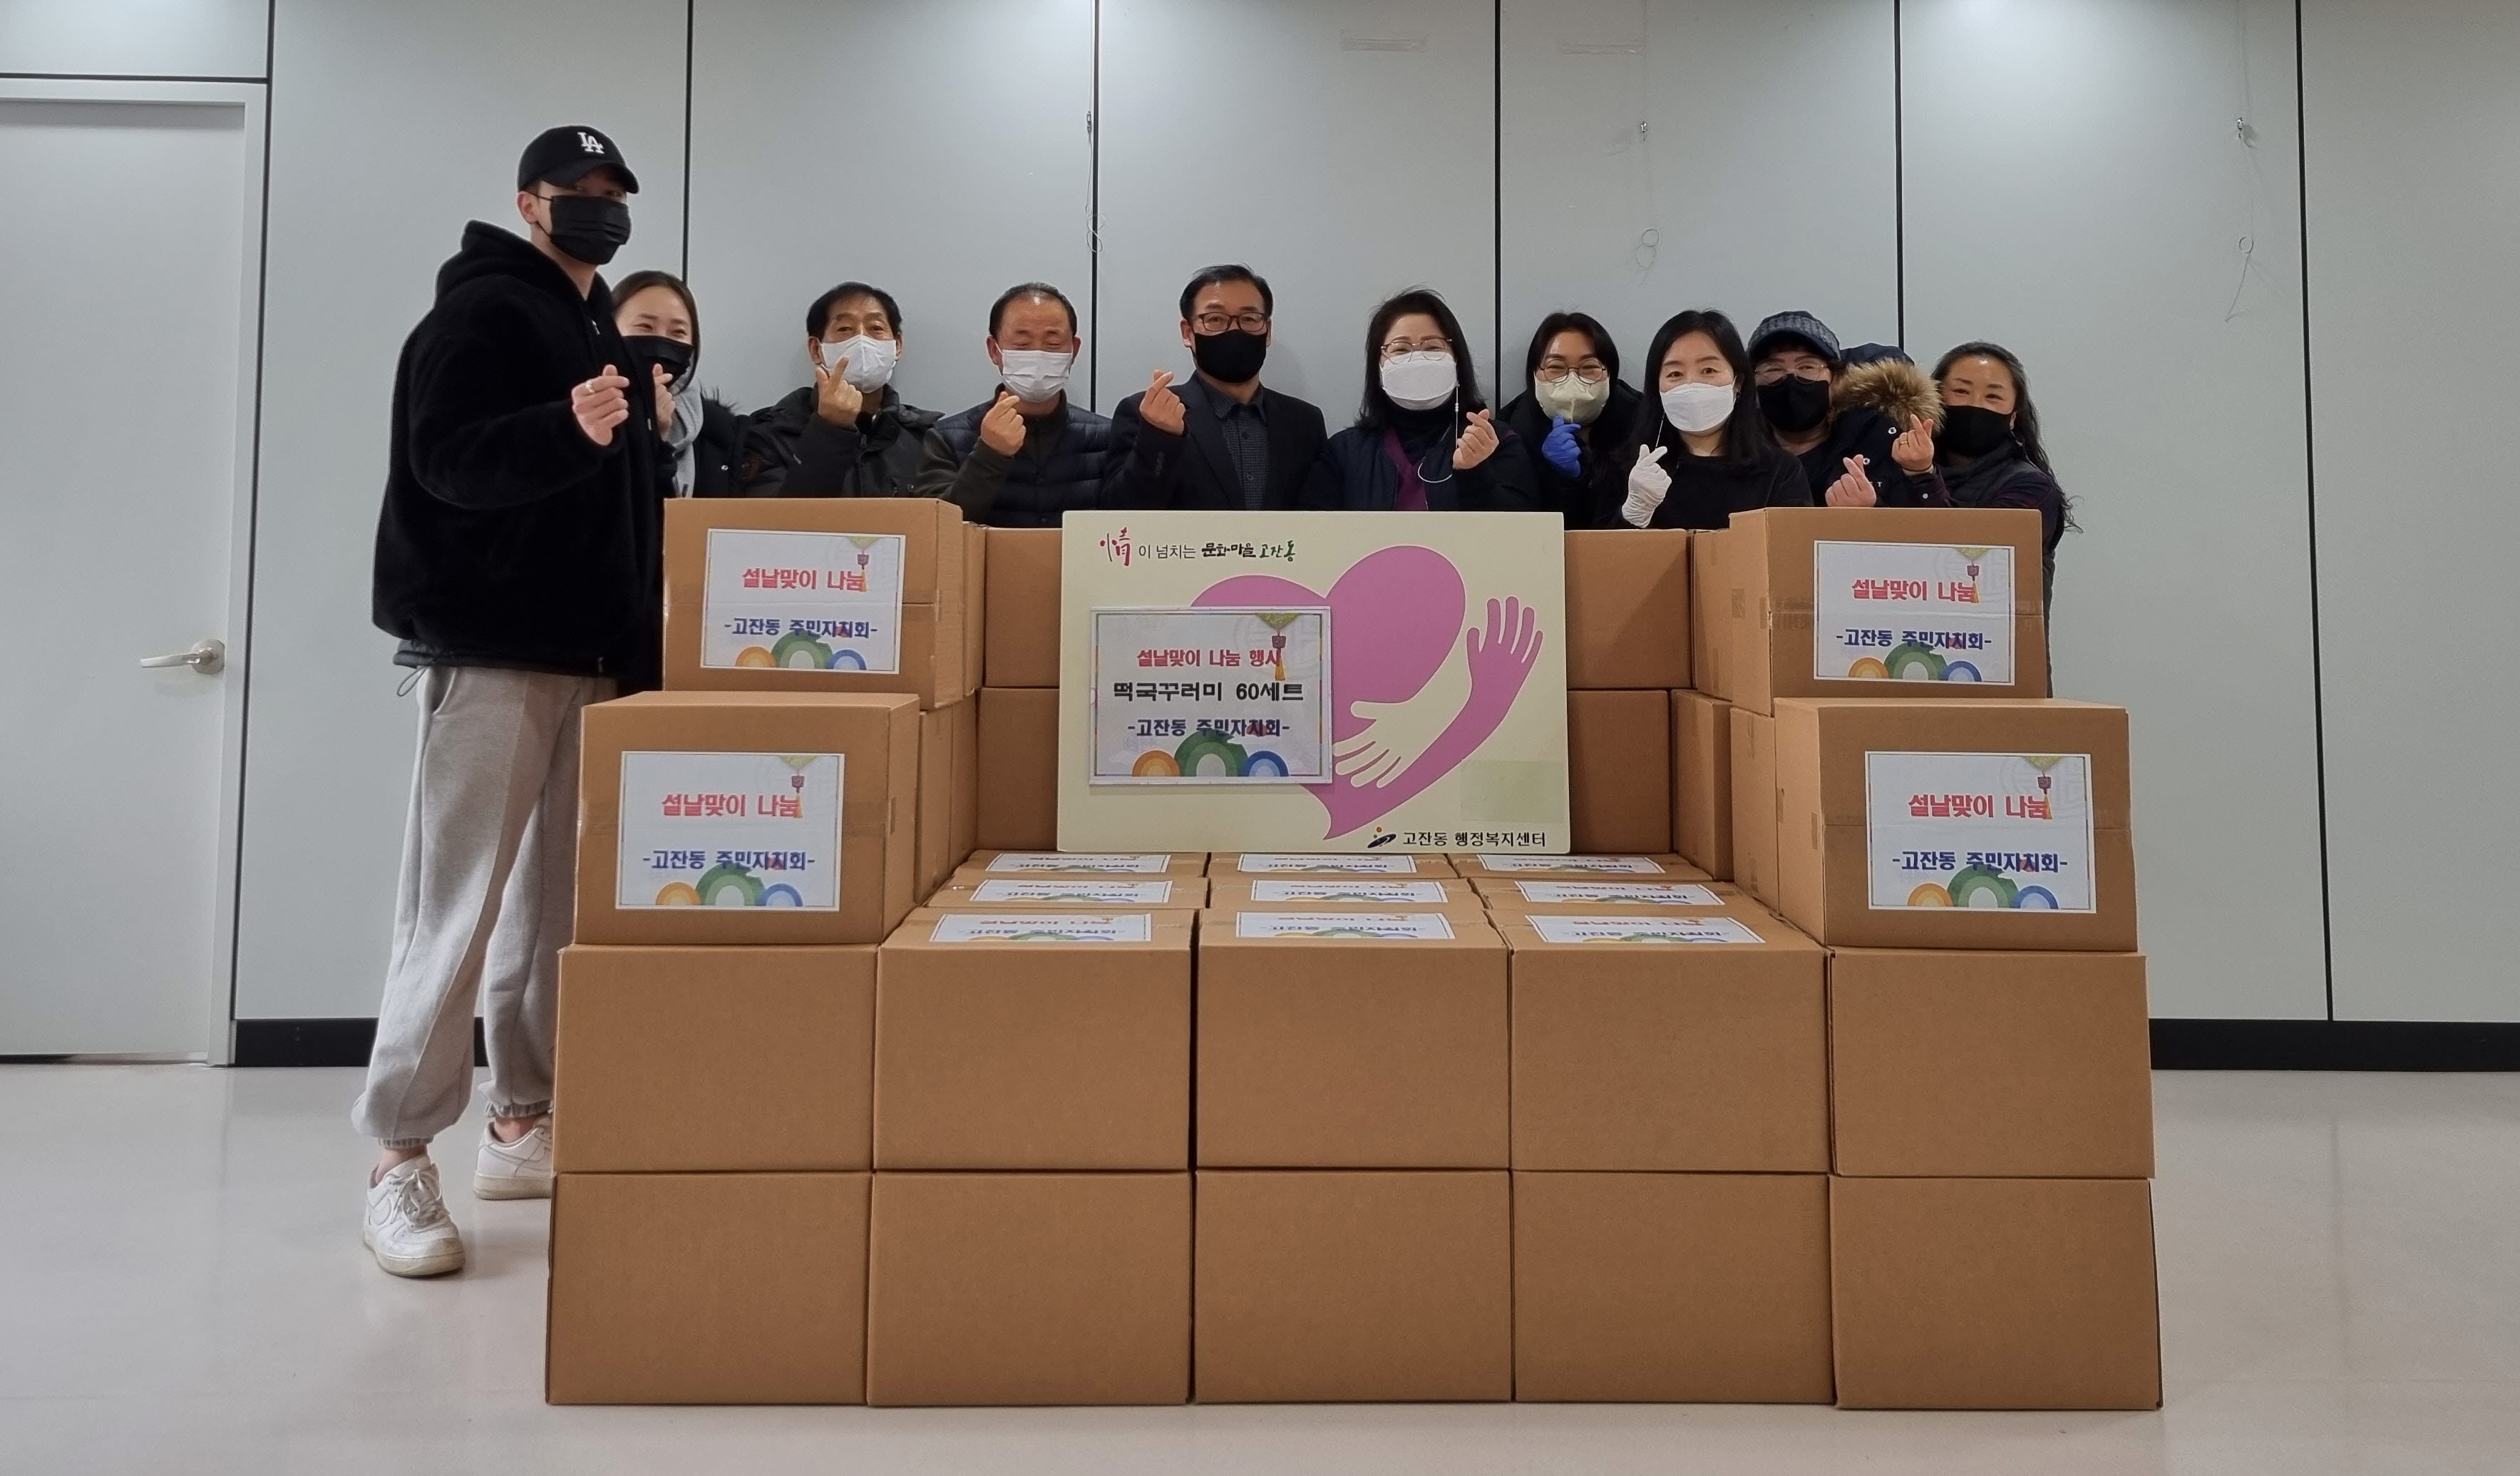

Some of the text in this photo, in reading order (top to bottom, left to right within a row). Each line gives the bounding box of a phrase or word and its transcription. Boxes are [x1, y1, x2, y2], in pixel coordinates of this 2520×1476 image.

[577, 131, 605, 154] LA
[1156, 544, 1196, 559] 넘치는
[1259, 540, 1296, 562] 고잔동
[742, 568, 866, 592] 설날맞이 나눔
[1851, 579, 1978, 604] 설날맞이 나눔
[1137, 649, 1282, 667] 설날맞이 나눔 행사
[1114, 682, 1304, 702] 떡국꾸러미 60세트
[662, 793, 802, 819] 설날맞이 나눔
[1908, 794, 2052, 820] 설날맞이 나눔
[1403, 831, 1546, 847] 고잔동 행정복지센터
